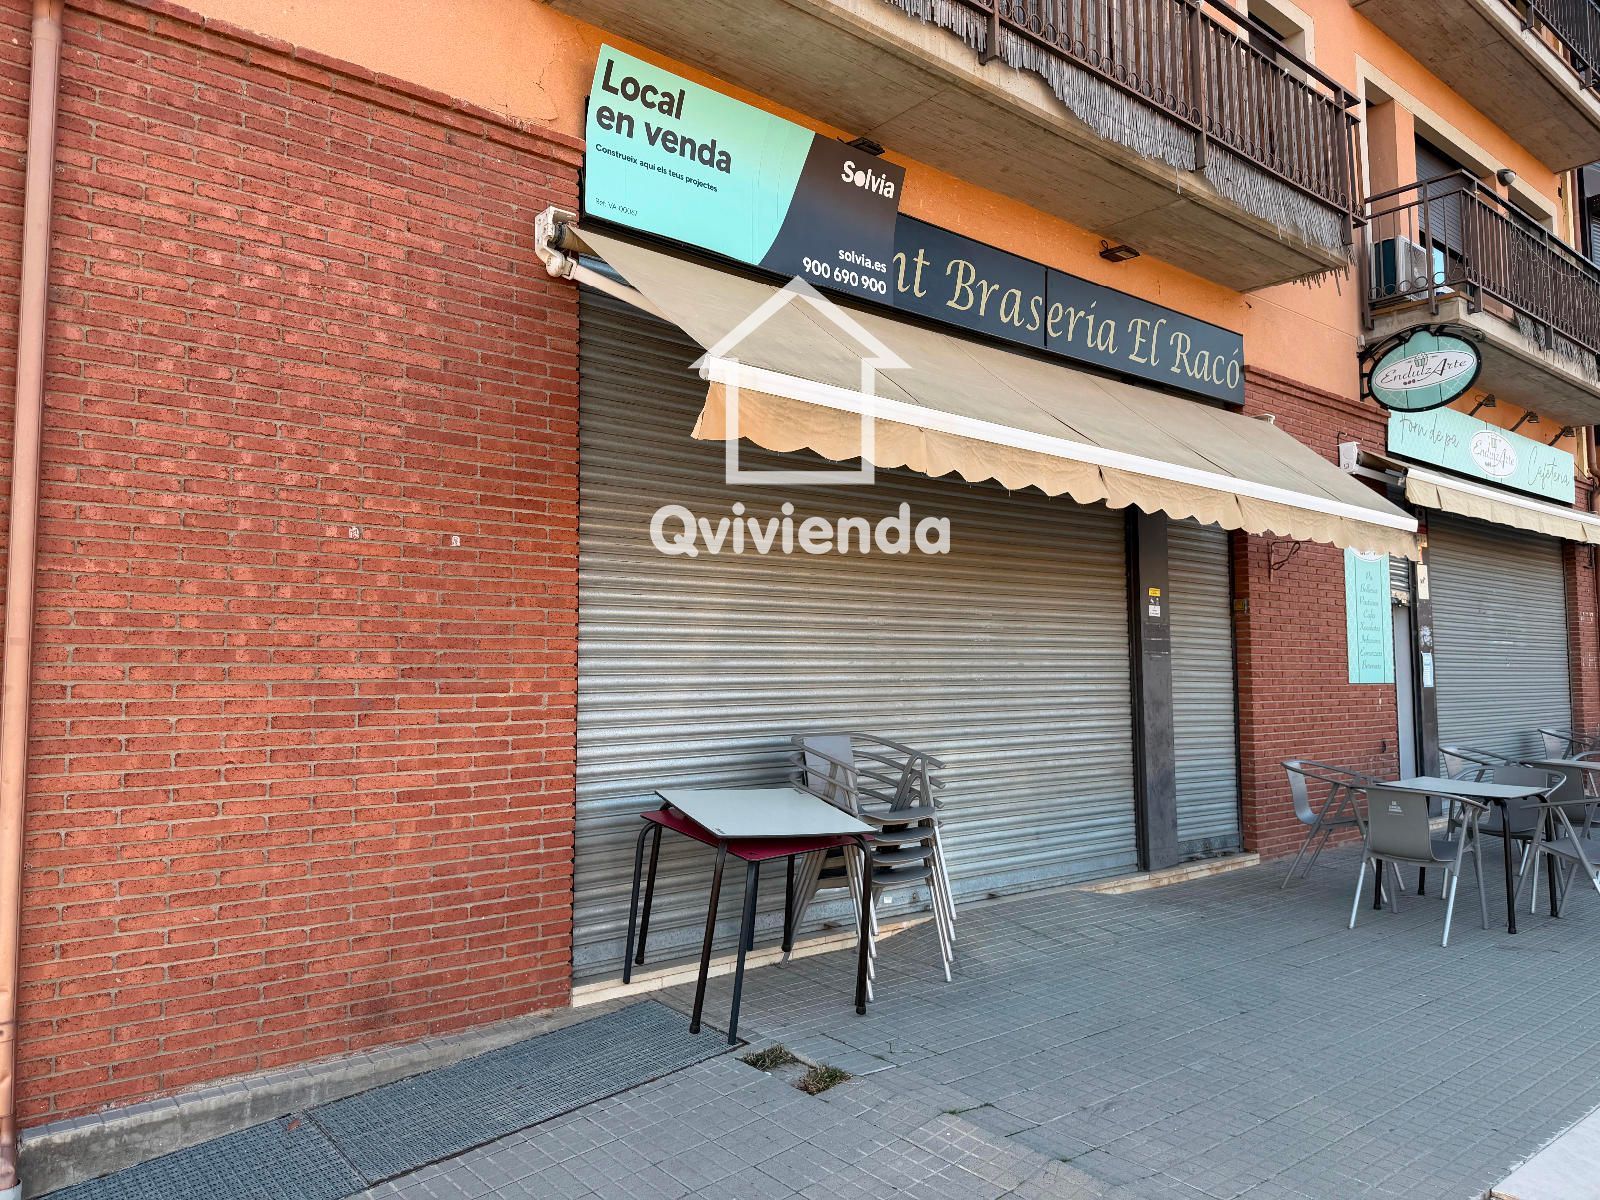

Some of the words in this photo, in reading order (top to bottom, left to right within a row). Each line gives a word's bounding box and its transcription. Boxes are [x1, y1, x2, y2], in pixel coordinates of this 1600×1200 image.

[601, 58, 685, 120] Local
[595, 104, 635, 139] en
[644, 120, 732, 174] venda
[595, 143, 638, 164] Construeix
[656, 165, 667, 175] els
[668, 169, 684, 181] teus
[685, 175, 718, 192] projectes
[841, 160, 895, 199] Solvia
[802, 256, 831, 279] 900
[833, 263, 859, 287] 690
[861, 271, 887, 295] 900
[838, 249, 887, 273] solvia.es
[1127, 318, 1167, 367] El
[1170, 332, 1240, 390] Racó
[1380, 357, 1467, 384] EndulzArte
